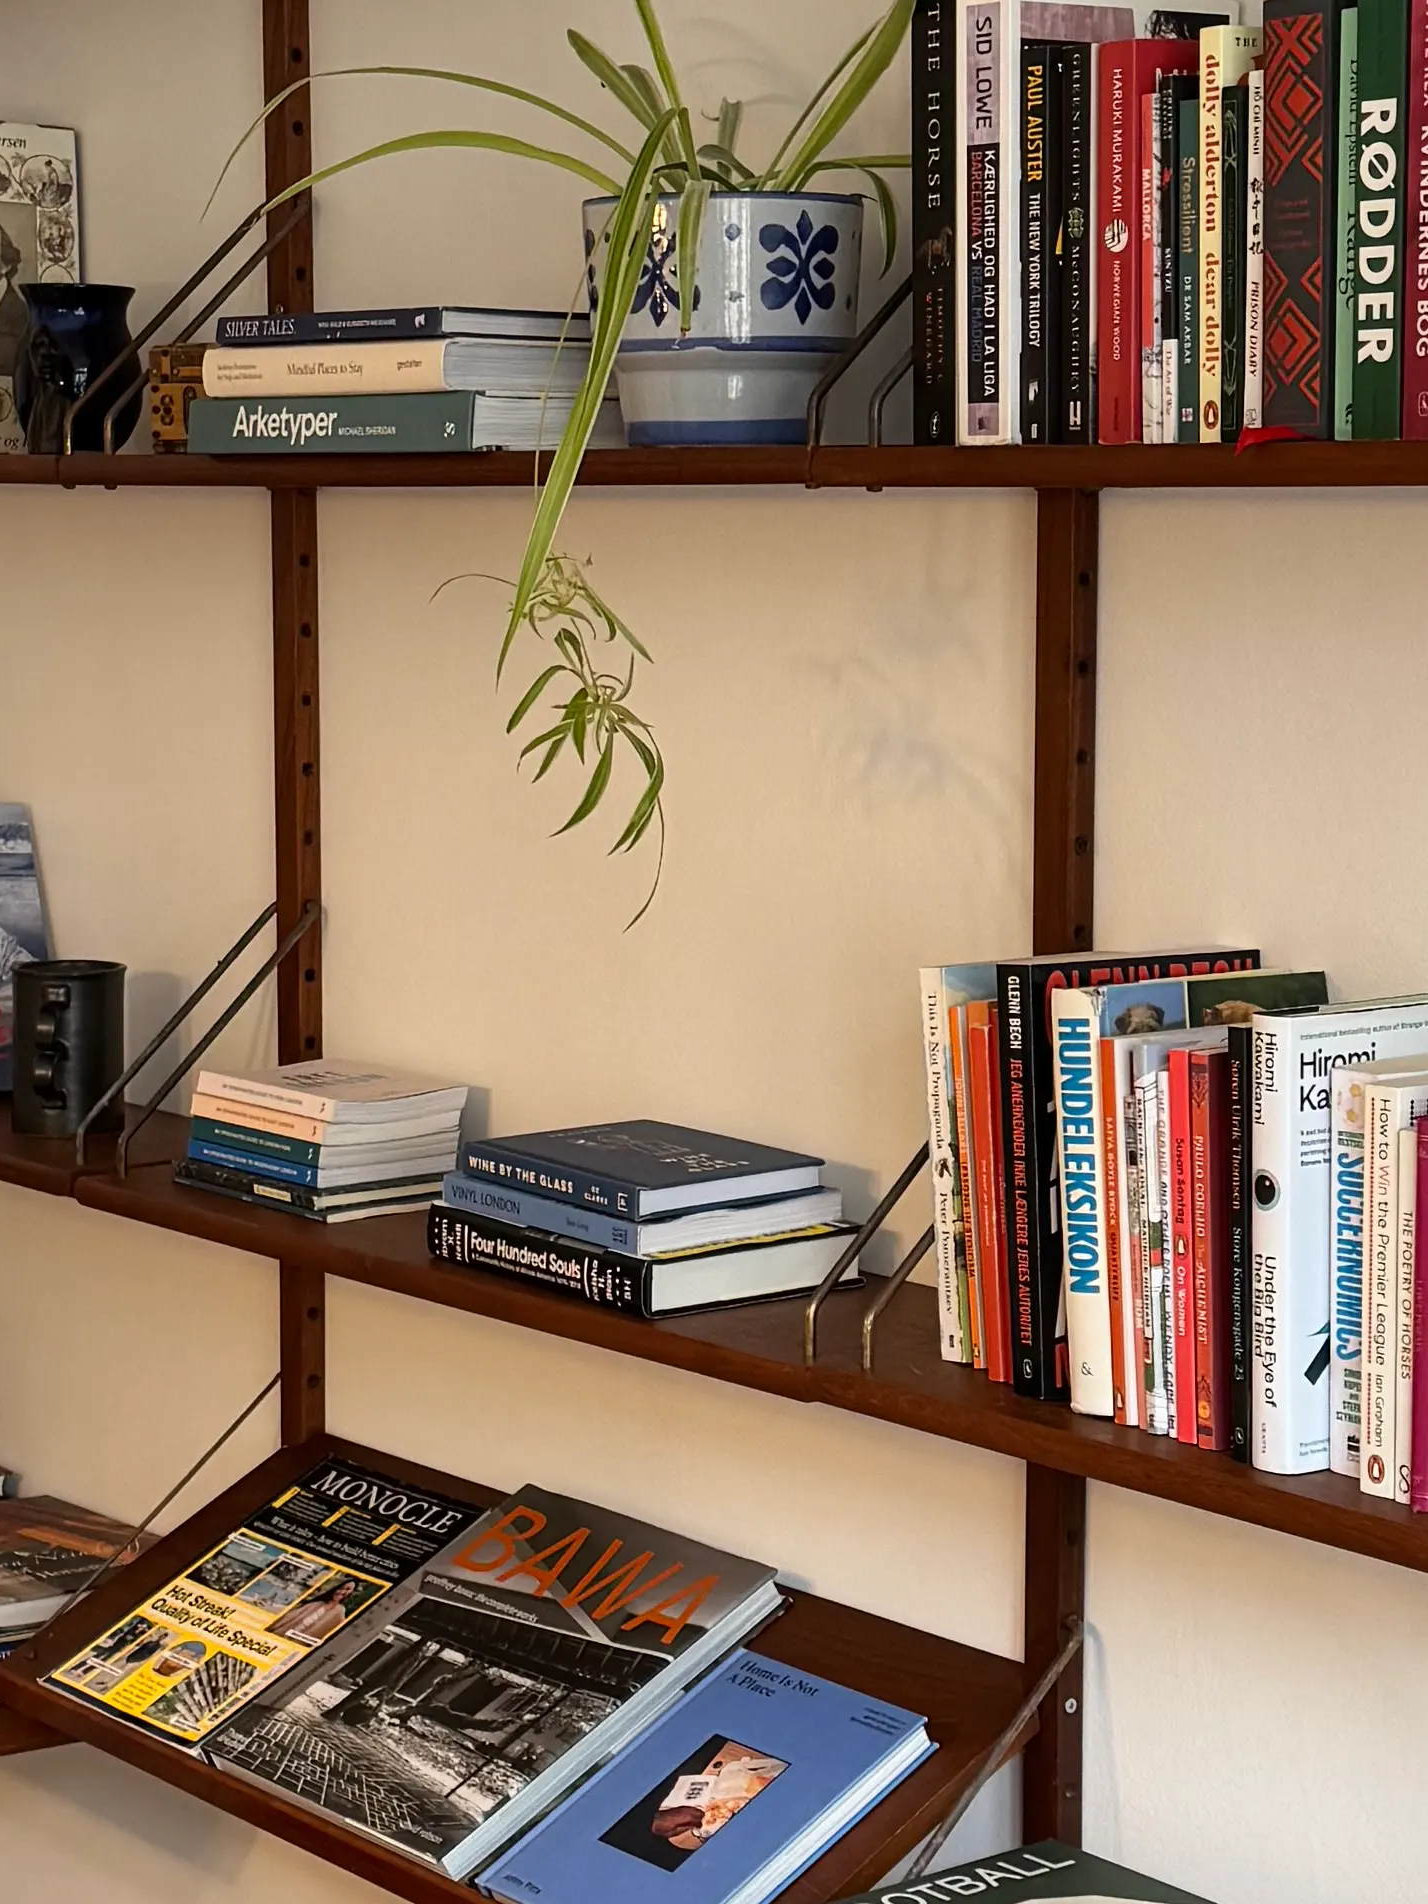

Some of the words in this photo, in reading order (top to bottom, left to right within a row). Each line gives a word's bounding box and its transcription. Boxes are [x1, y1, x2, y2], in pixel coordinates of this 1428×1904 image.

[927, 3, 941, 73] THE
[975, 16, 992, 56] SID
[975, 65, 992, 130] LOWE
[1027, 65, 1043, 110] PAUL
[1112, 68, 1122, 126] HARUKI
[1204, 54, 1220, 119] dolly
[927, 92, 942, 208] HORSE
[1027, 116, 1043, 183] AUSTER
[1112, 130, 1123, 213] MURAKAMI
[1204, 125, 1221, 232] alderton
[1142, 168, 1151, 241] MALLORCA
[1357, 96, 1398, 365] RØDDER
[1112, 260, 1121, 323] NORWEGIAN
[1249, 280, 1260, 335] PRISON
[224, 318, 259, 337] SILVER
[262, 318, 296, 336] TALES
[1112, 326, 1121, 361] WOOD
[396, 358, 423, 372] gestalten
[1249, 338, 1259, 378] DIARY
[1007, 975, 1020, 1013] GLENN
[1009, 1016, 1022, 1049] BECH
[1265, 1032, 1278, 1092] Hiromi
[1254, 1031, 1265, 1125] Kawakami
[1300, 1084, 1330, 1112] Ka
[1058, 1017, 1100, 1295] HUNDELEKSIKON
[471, 1231, 494, 1254] Four
[497, 1238, 547, 1268] Hundred
[549, 1254, 581, 1279] Souls
[1232, 1227, 1242, 1264] Store
[1233, 1268, 1244, 1358] Kongensgade
[1234, 1361, 1244, 1380] 23
[311, 1470, 464, 1534] MONOCLE
[165, 1585, 190, 1601] Hot
[186, 1593, 234, 1620] Streak!
[452, 1505, 720, 1646] BAWA
